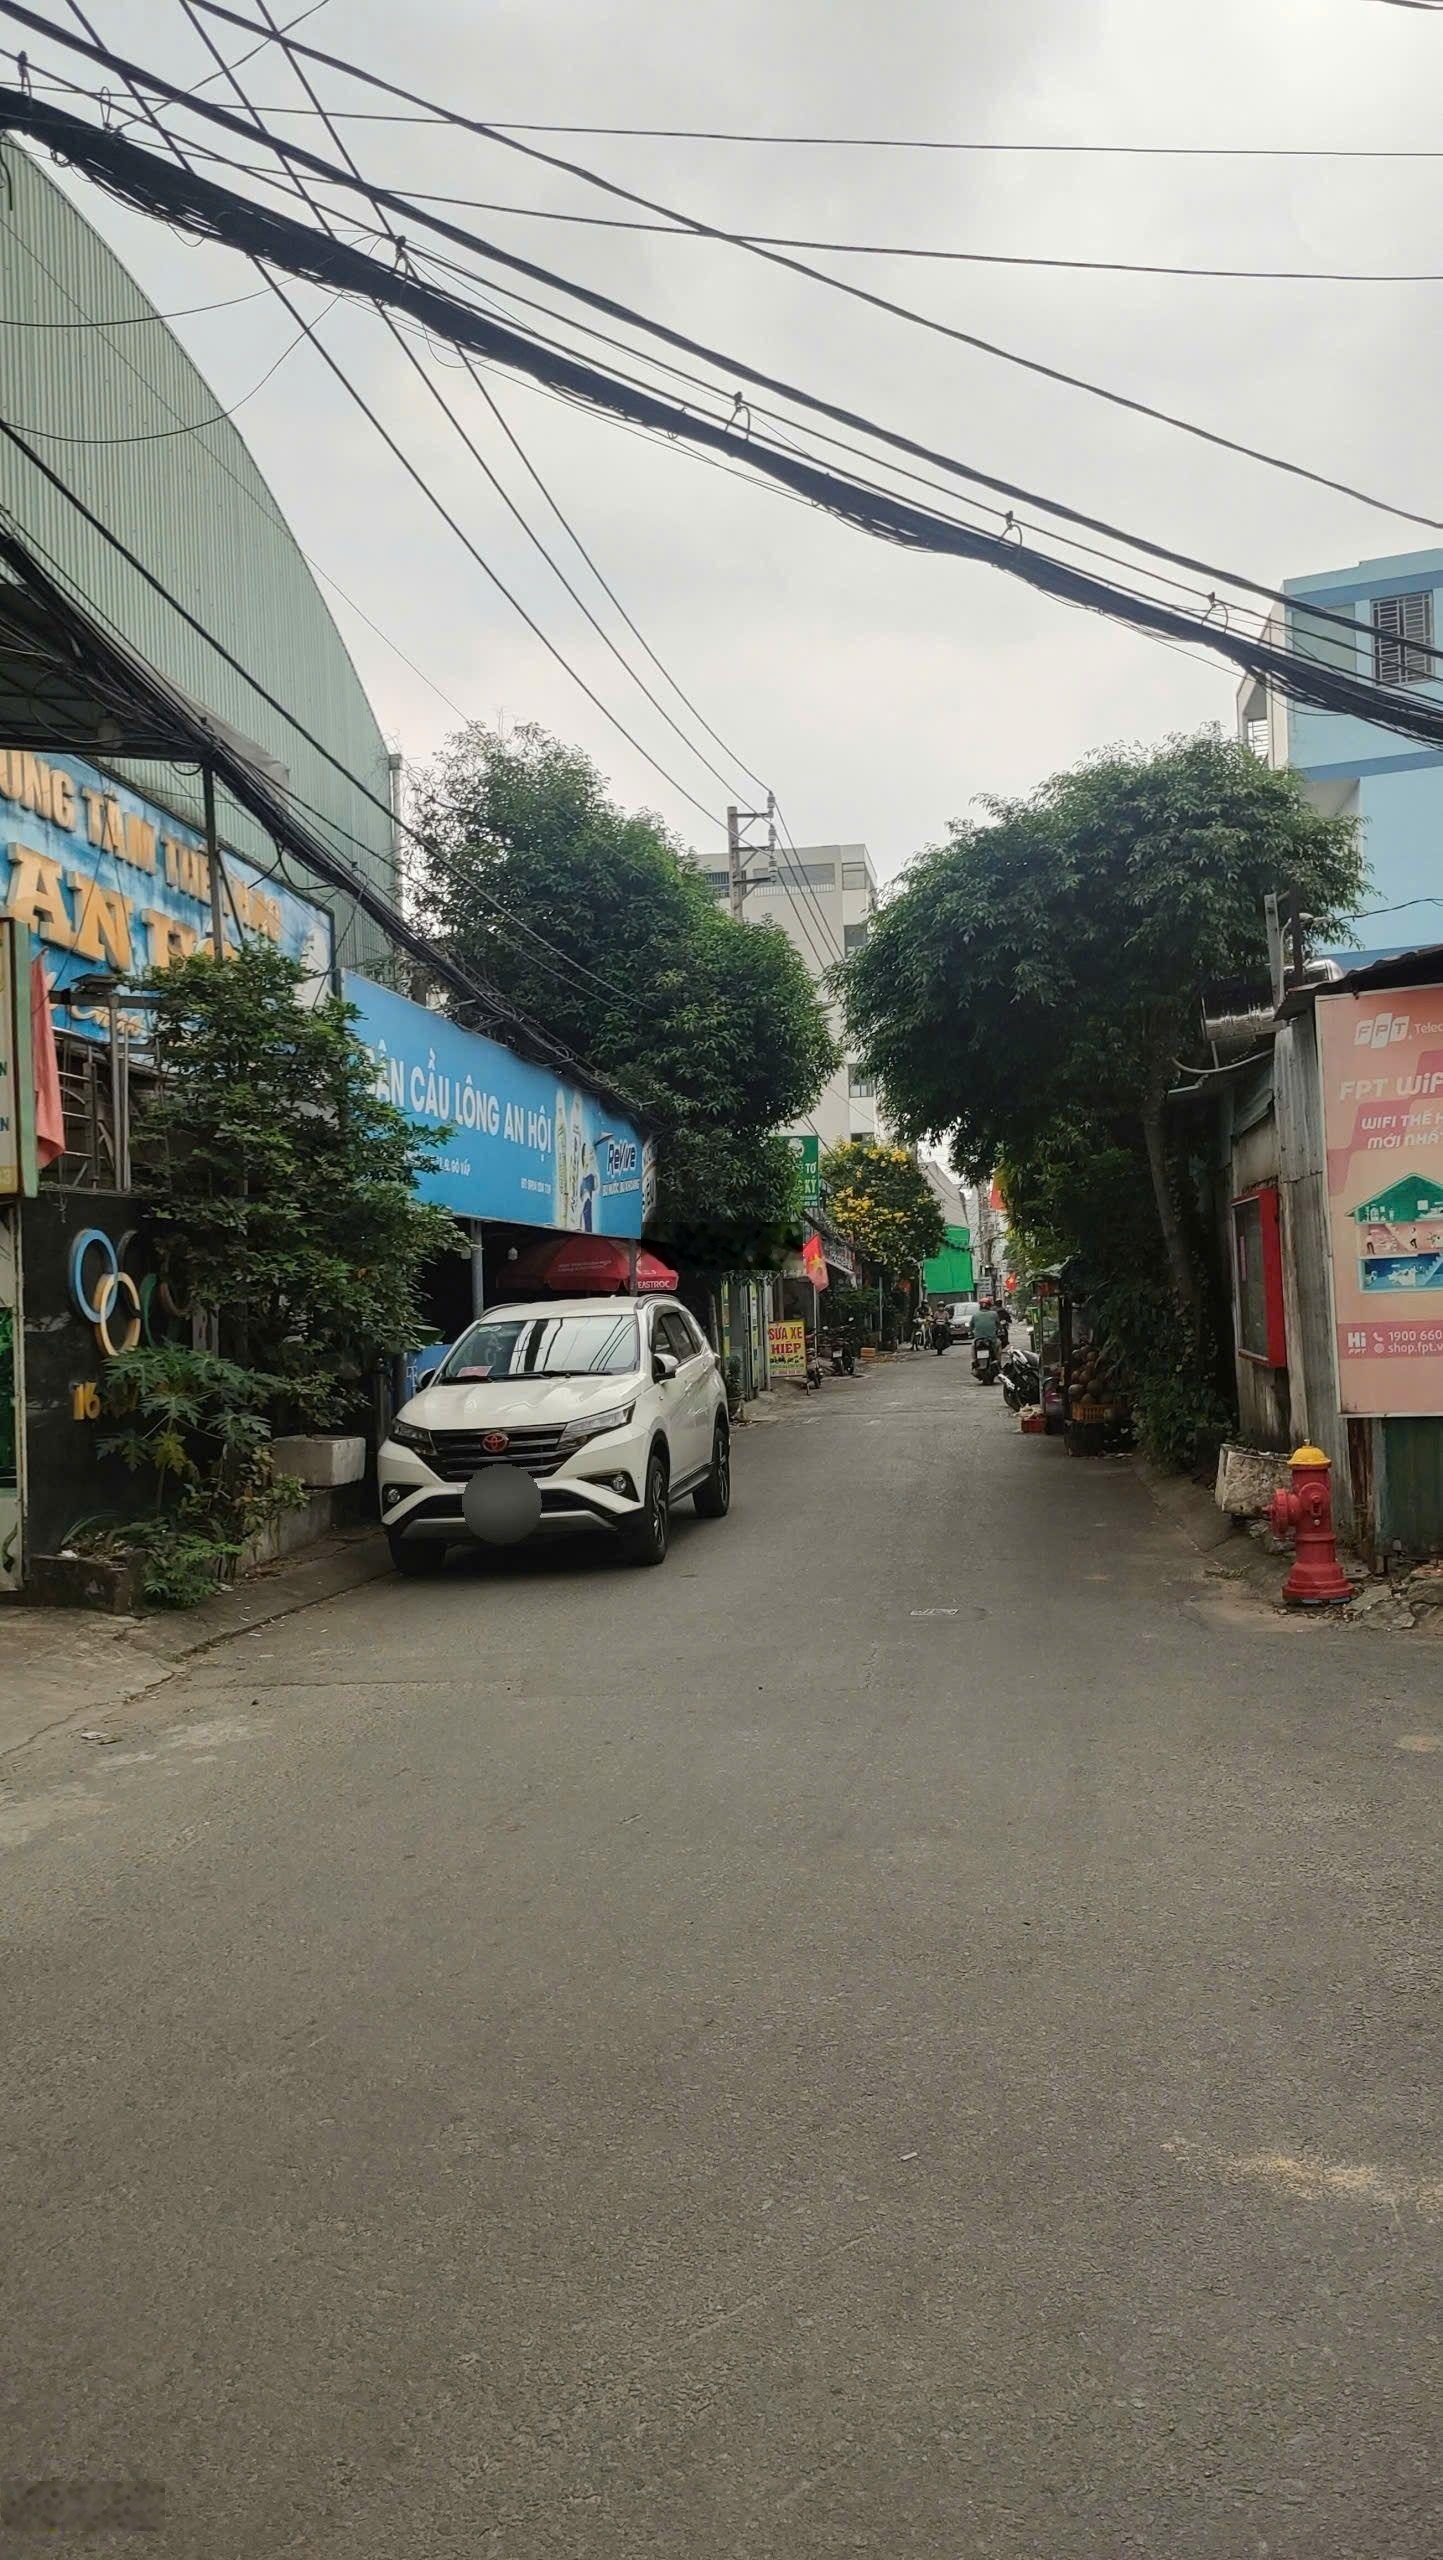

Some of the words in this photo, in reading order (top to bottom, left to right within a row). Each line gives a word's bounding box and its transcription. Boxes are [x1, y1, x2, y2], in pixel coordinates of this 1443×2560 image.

[8, 841, 134, 971] AN
[1354, 1012, 1410, 1048] FPT
[1340, 1078, 1388, 1100] FPT
[455, 1074, 499, 1136] LÔNG
[504, 1102, 524, 1145] AN
[528, 1105, 551, 1162] HỘI
[1361, 1116, 1396, 1130] WIFI
[1400, 1108, 1432, 1127] THẾ
[790, 1326, 803, 1339] XE
[1347, 1331, 1366, 1348] Hi
[1388, 1330, 1416, 1342] 1900
[1420, 1329, 1442, 1341] 660
